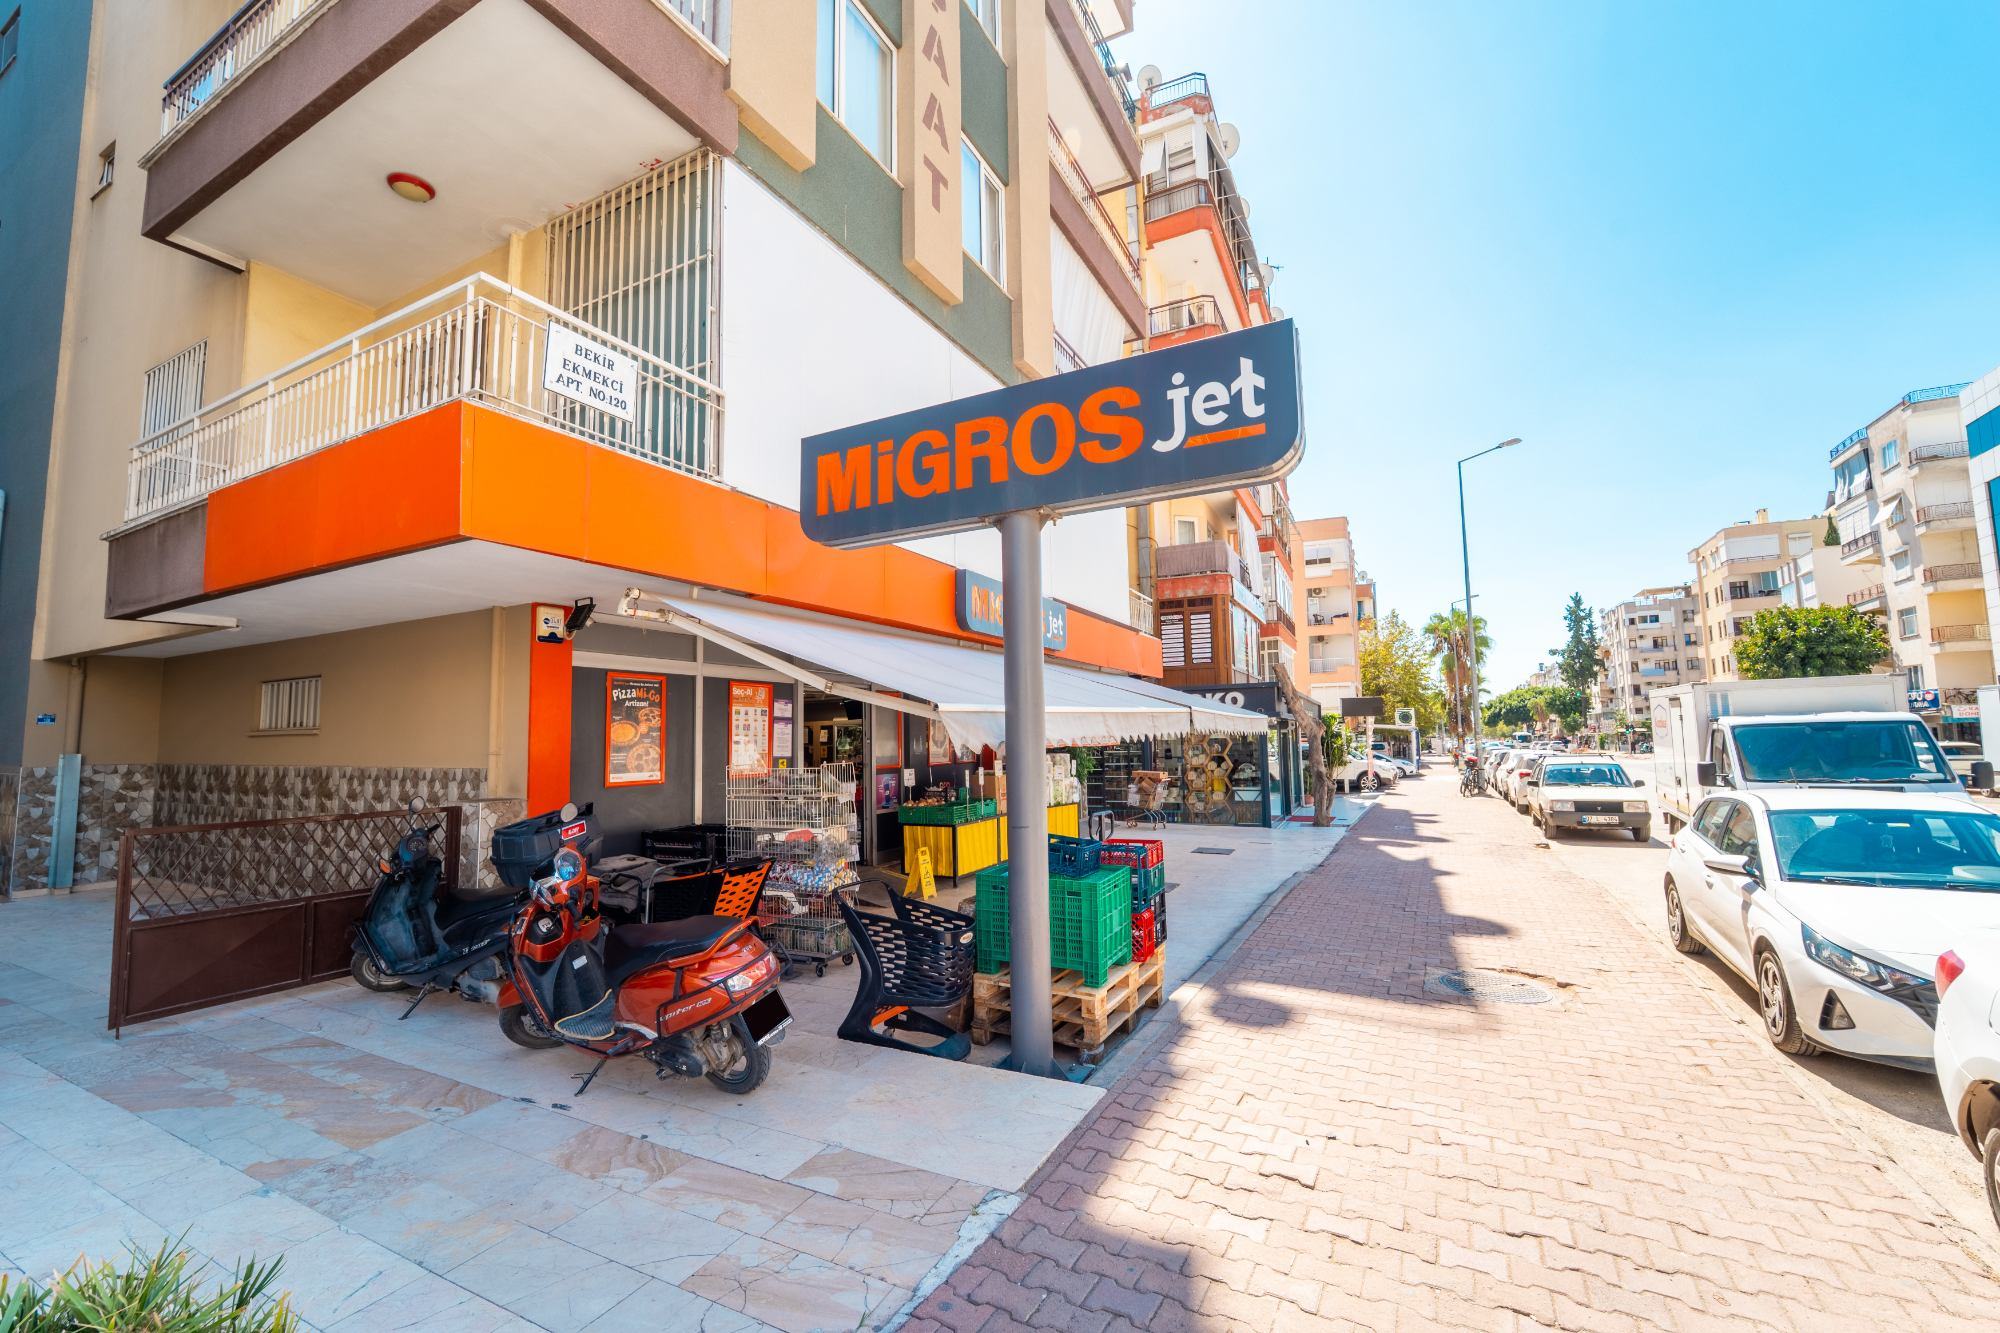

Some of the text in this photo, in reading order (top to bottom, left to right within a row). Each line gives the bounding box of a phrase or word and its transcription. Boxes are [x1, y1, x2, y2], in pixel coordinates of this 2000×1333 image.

[575, 343, 615, 371] BEKİR
[555, 373, 583, 394] APT.
[1151, 356, 1266, 453] jet
[1046, 610, 1064, 639] jet
